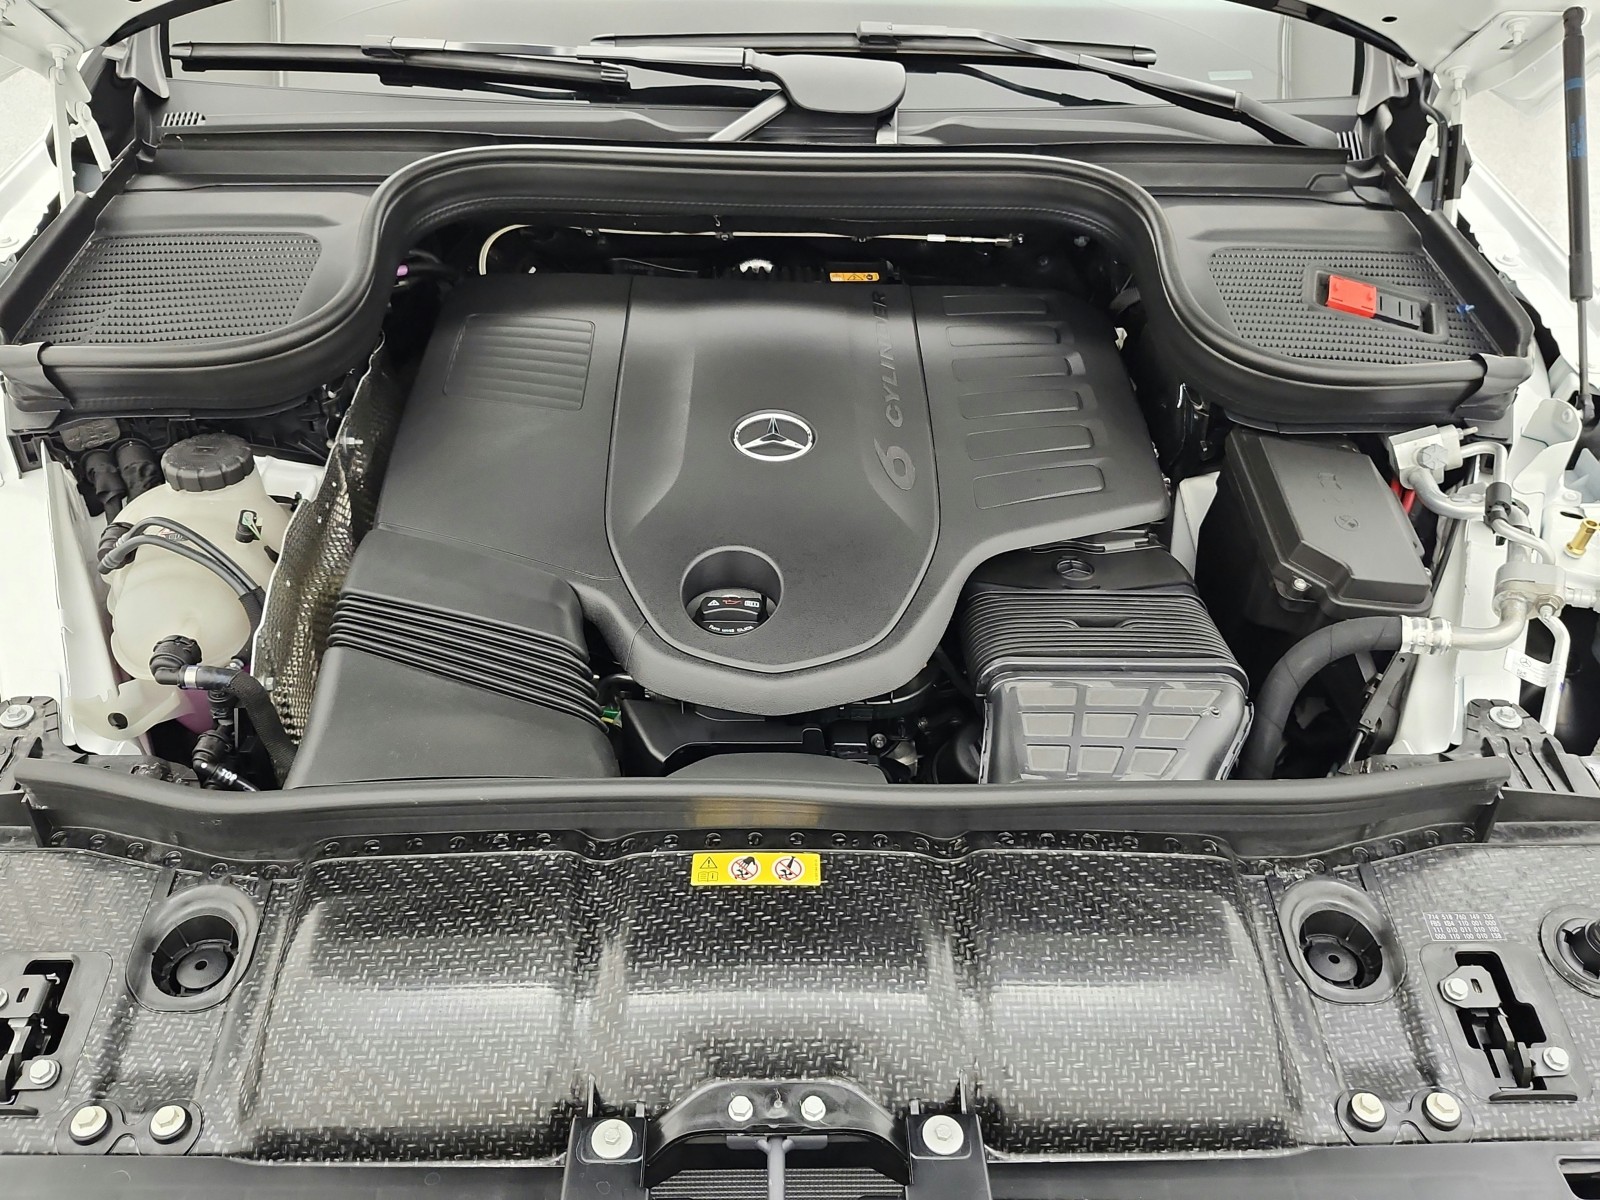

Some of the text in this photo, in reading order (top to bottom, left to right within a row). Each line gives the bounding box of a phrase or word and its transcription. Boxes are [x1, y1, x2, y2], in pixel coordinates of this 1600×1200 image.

[872, 290, 916, 491] 6 CYLINDER
[219, 768, 238, 785] TOP
